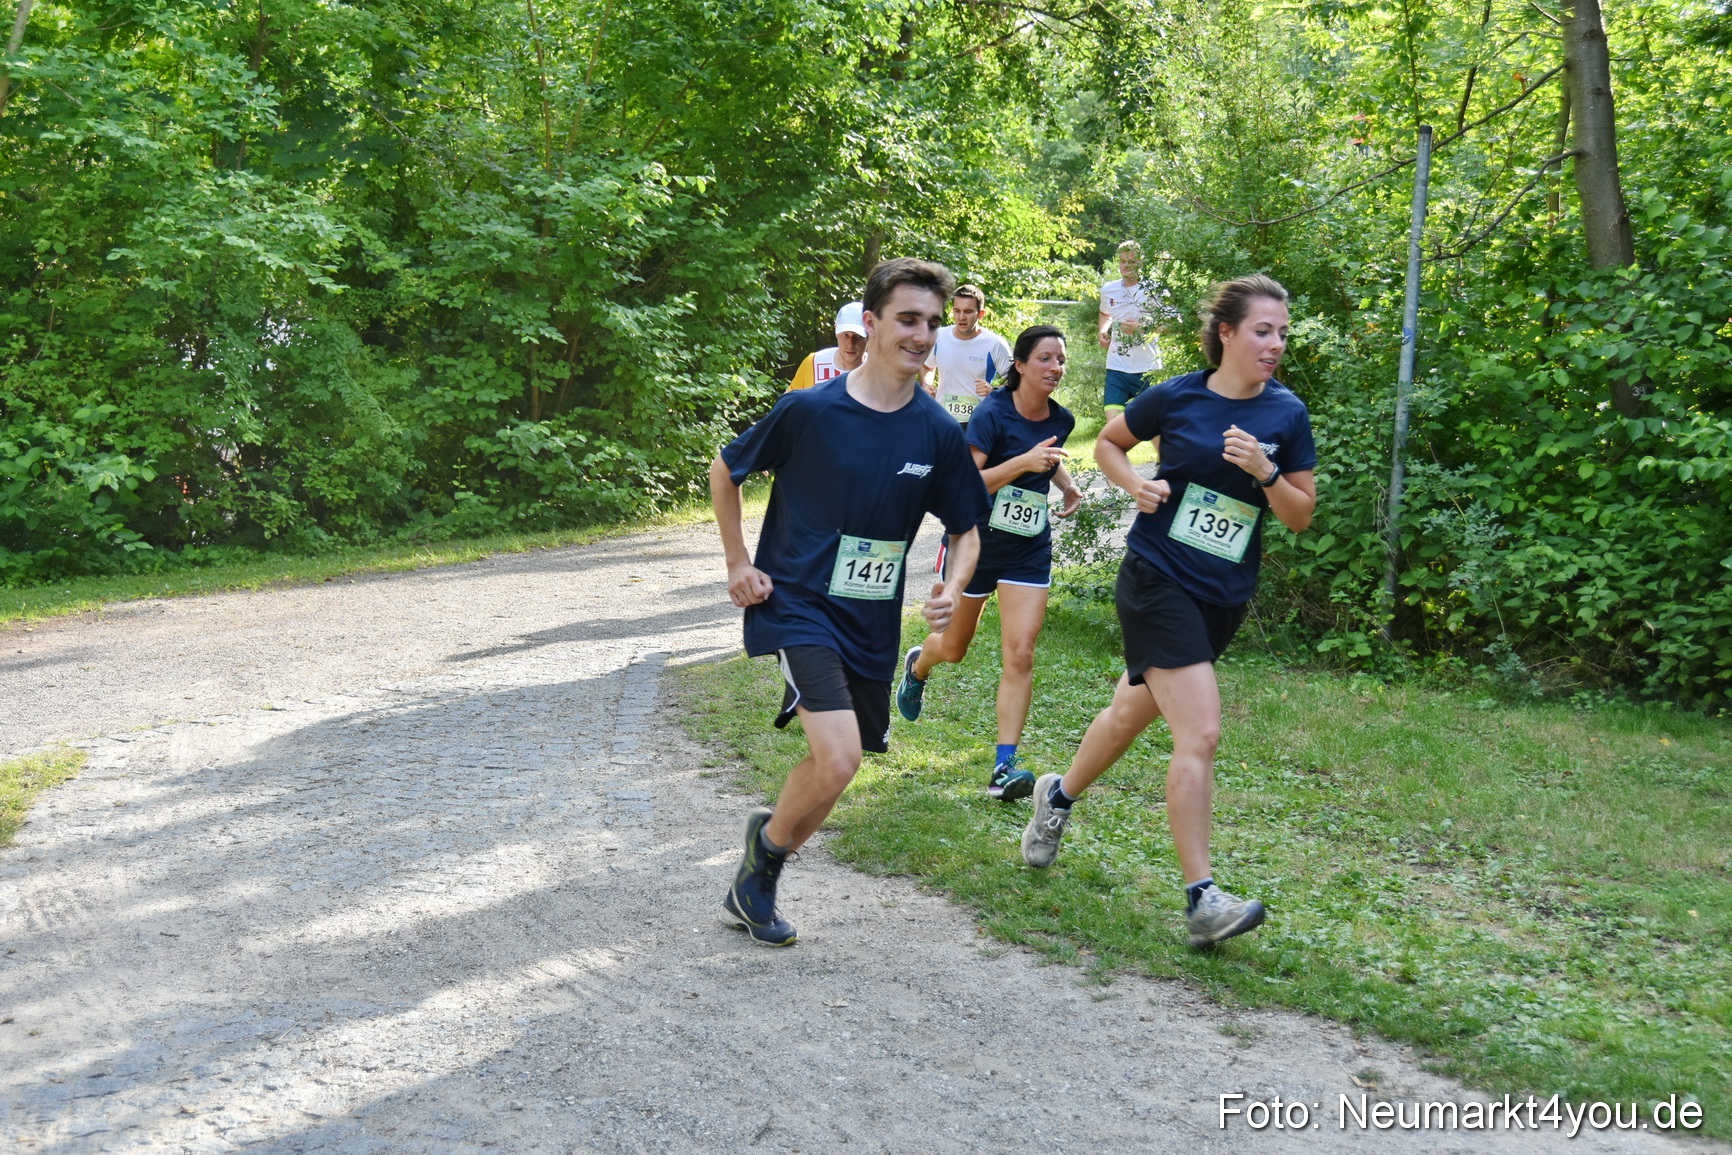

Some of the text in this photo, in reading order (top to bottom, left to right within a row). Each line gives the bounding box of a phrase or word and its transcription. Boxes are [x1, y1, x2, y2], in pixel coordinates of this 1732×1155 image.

[948, 403, 974, 415] 1838
[1002, 502, 1040, 525] 1391
[1189, 507, 1244, 542] 1397
[846, 559, 895, 583] 1412
